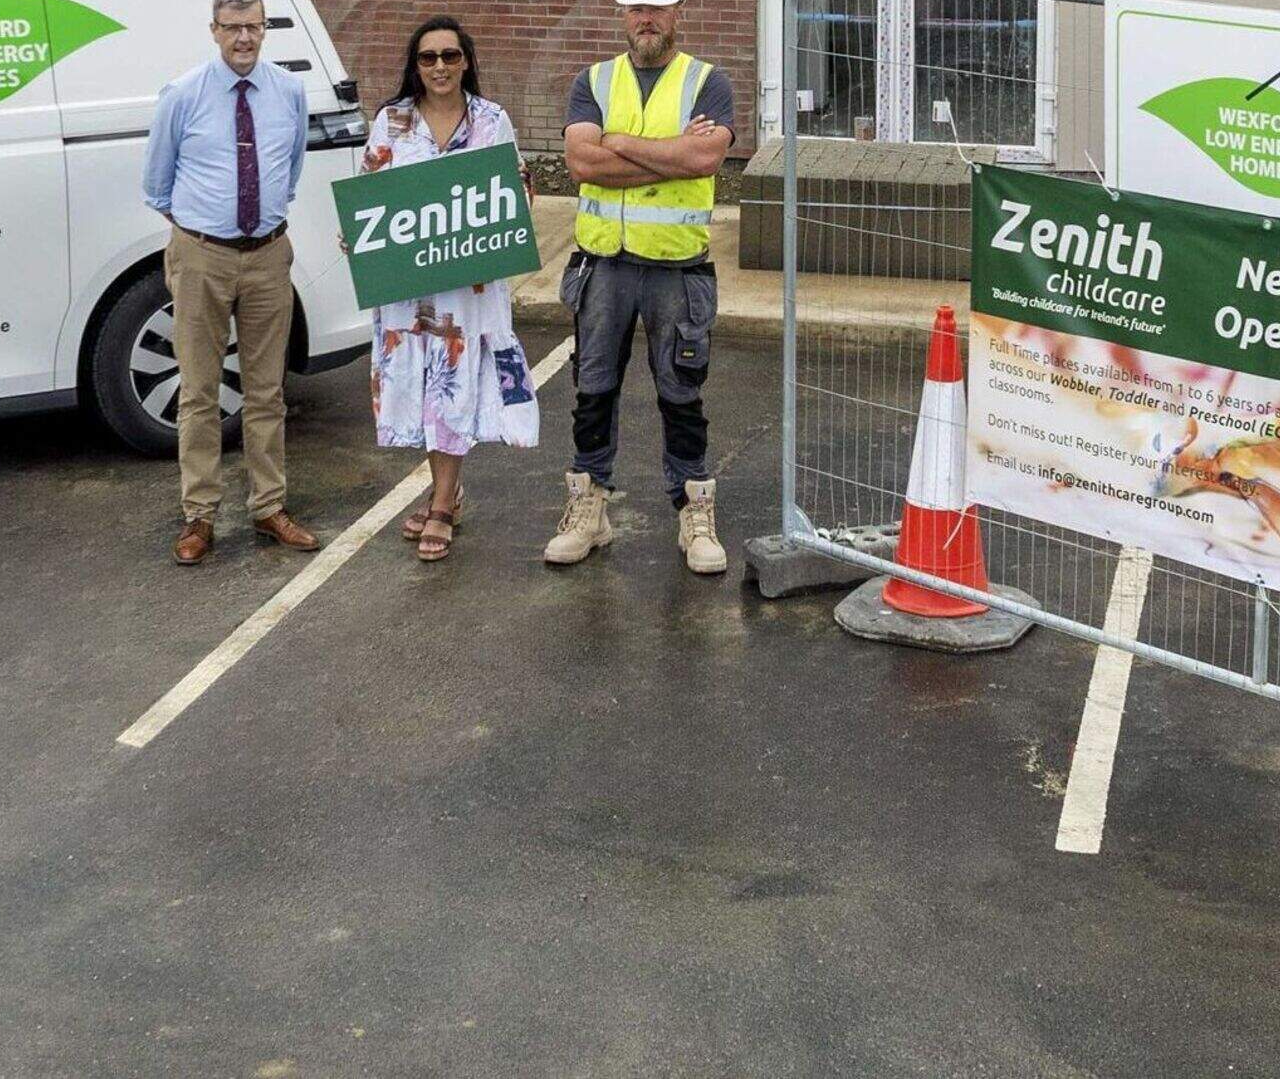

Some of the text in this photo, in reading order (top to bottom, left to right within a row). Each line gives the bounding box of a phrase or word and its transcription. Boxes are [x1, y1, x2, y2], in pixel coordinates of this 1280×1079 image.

[1205, 129, 1246, 150] LOW
[353, 174, 517, 255] Zenith
[414, 228, 528, 267] childcare
[991, 199, 1163, 281] Zenith
[1029, 297, 1073, 317] childcare
[1073, 305, 1090, 318] for
[1046, 269, 1166, 315] childcare
[989, 338, 1010, 354] Full
[1012, 344, 1040, 362] Time
[1043, 354, 1079, 374] places
[1082, 362, 1141, 385] available
[1143, 374, 1174, 393] from
[1177, 383, 1184, 396] 1
[1188, 385, 1202, 401] to
[1206, 389, 1214, 403] 6
[1217, 394, 1253, 412] years
[1256, 401, 1272, 415] of
[989, 377, 1054, 404] classrooms.
[989, 358, 1024, 377] across
[1026, 370, 1047, 382] our
[1050, 373, 1103, 399] Wobbler,
[1109, 387, 1161, 409] Toddler
[1163, 400, 1184, 417] and
[1189, 407, 1256, 433] Preschool
[988, 413, 1018, 433] Don't
[1021, 424, 1046, 441] miss
[1049, 432, 1073, 448] out!
[1076, 437, 1127, 461] Register
[1130, 454, 1159, 472] your
[1162, 462, 1215, 482] interest
[987, 450, 1214, 524] Email us: info@zenithcaregroup.com
